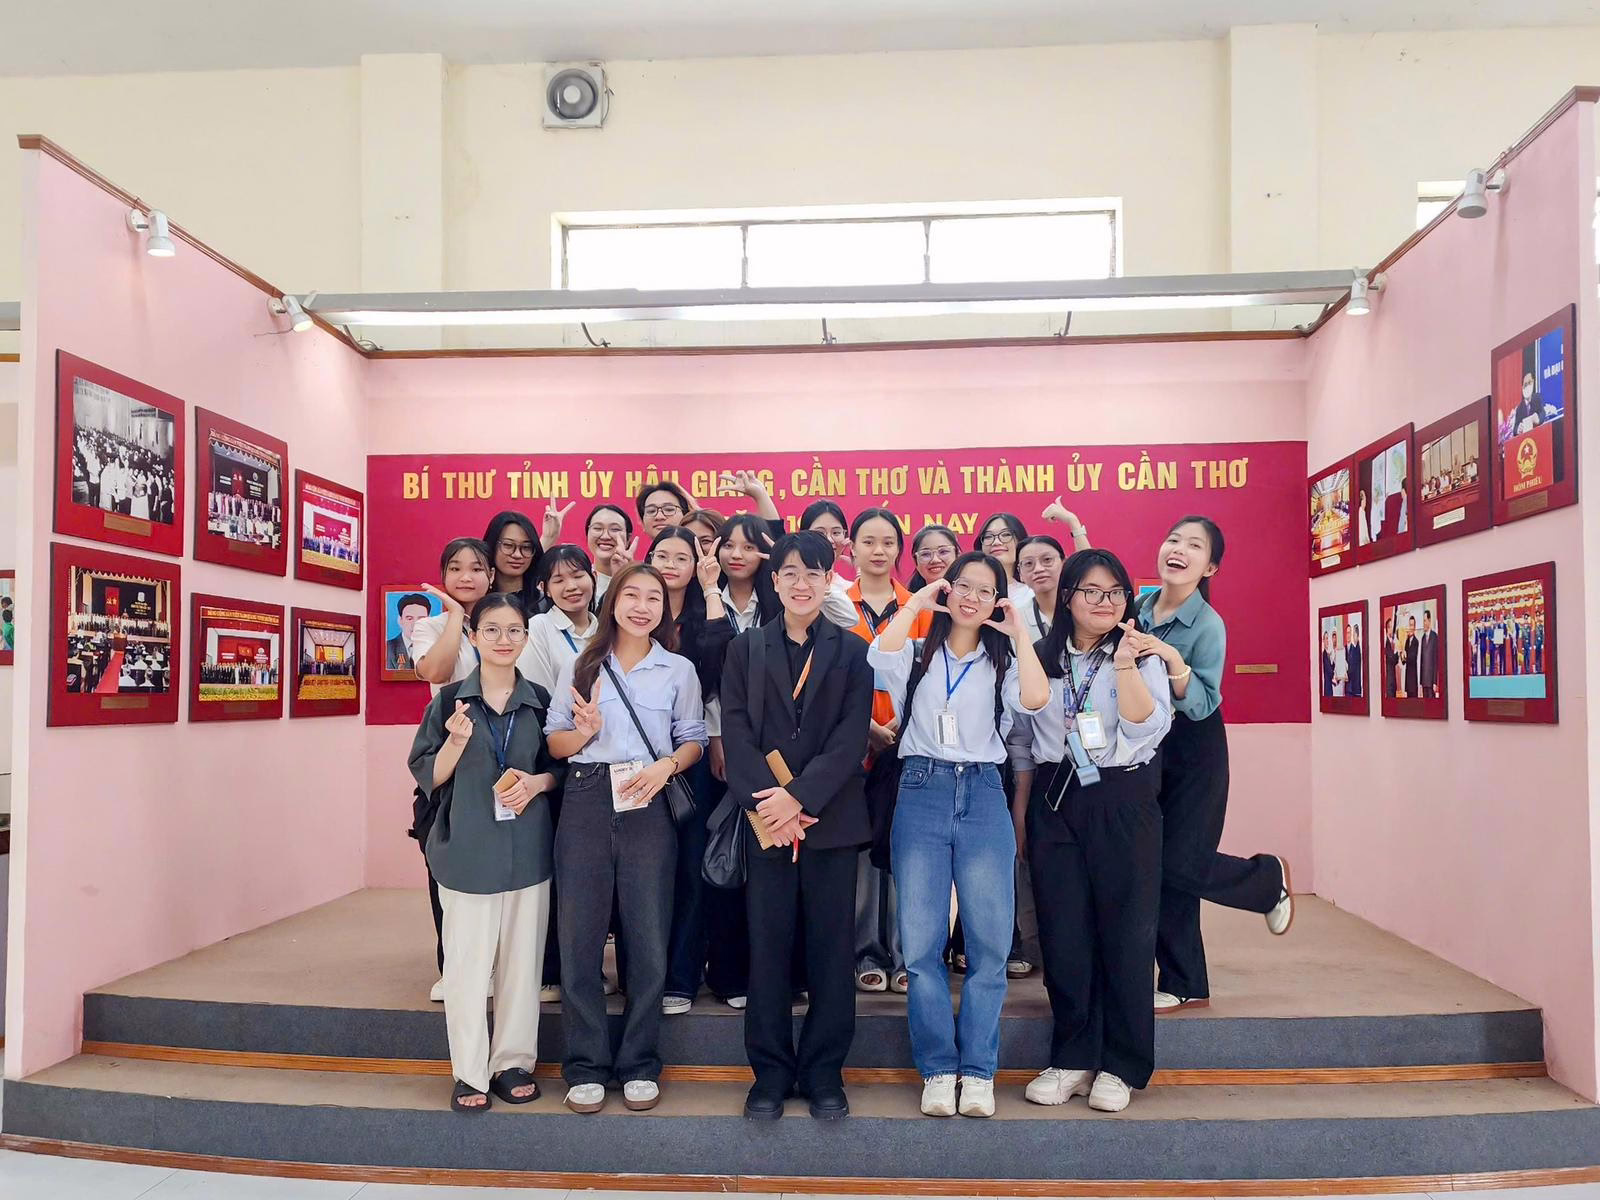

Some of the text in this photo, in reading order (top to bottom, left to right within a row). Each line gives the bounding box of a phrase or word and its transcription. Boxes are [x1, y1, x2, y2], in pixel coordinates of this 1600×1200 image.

[403, 465, 430, 499] BÍ
[443, 468, 498, 499] THƯ
[507, 460, 569, 499] TỈNH
[580, 459, 615, 498] ỦY
[791, 456, 847, 497] CẦN
[856, 465, 910, 495] THƠ
[917, 459, 951, 495] VÀ
[959, 458, 1055, 494] THÀNH
[1067, 452, 1104, 492] ỦY
[1117, 450, 1179, 491] CẦN
[1190, 457, 1250, 489] THƠ
[923, 513, 979, 535] NAY
